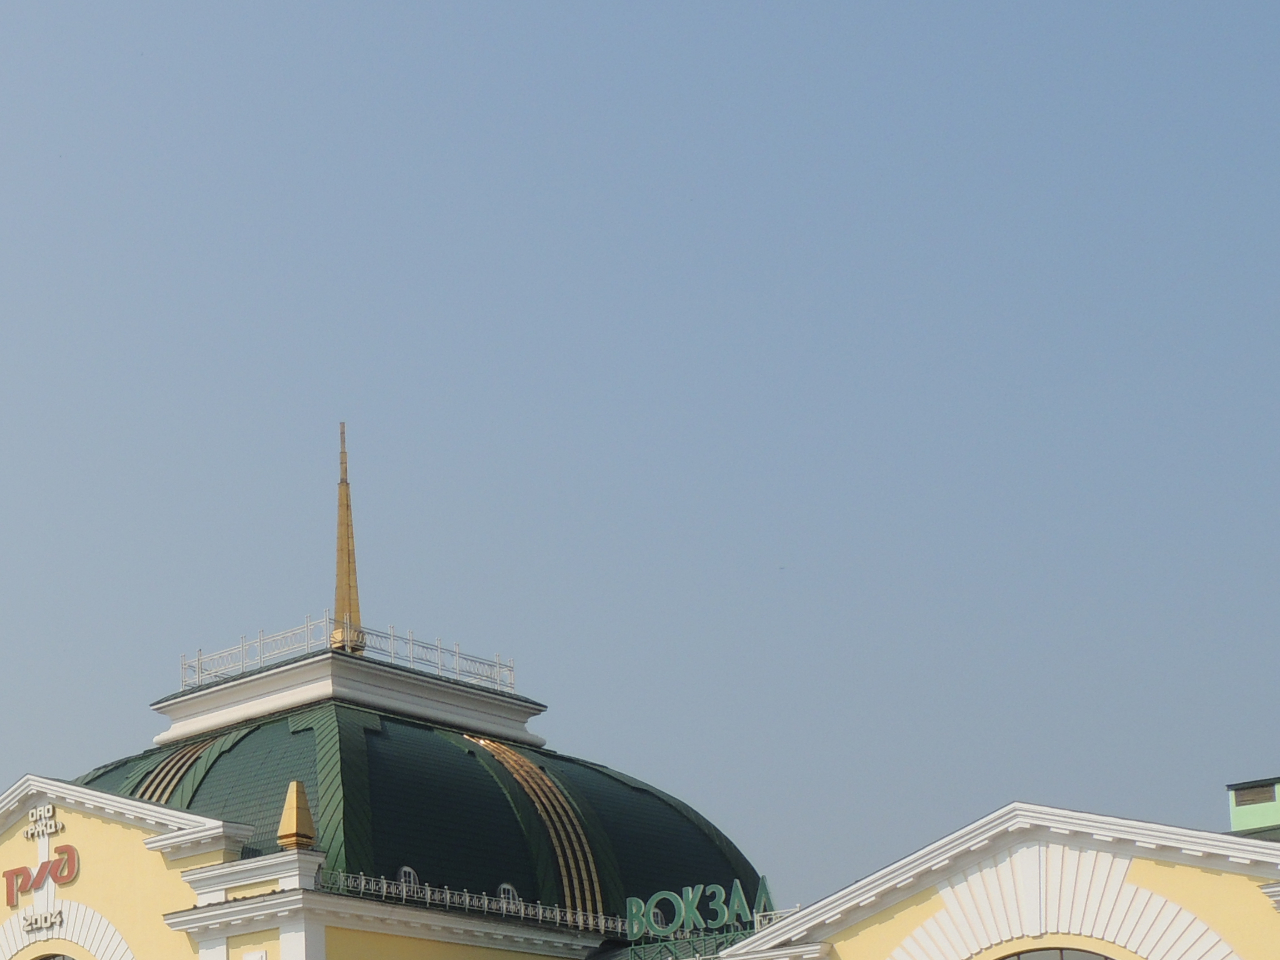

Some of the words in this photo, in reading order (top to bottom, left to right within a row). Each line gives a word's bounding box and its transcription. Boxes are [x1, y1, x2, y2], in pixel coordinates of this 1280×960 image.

[28, 804, 53, 822] ОАО
[626, 874, 774, 941] ВОКЗАЛ
[22, 911, 62, 931] 2004
